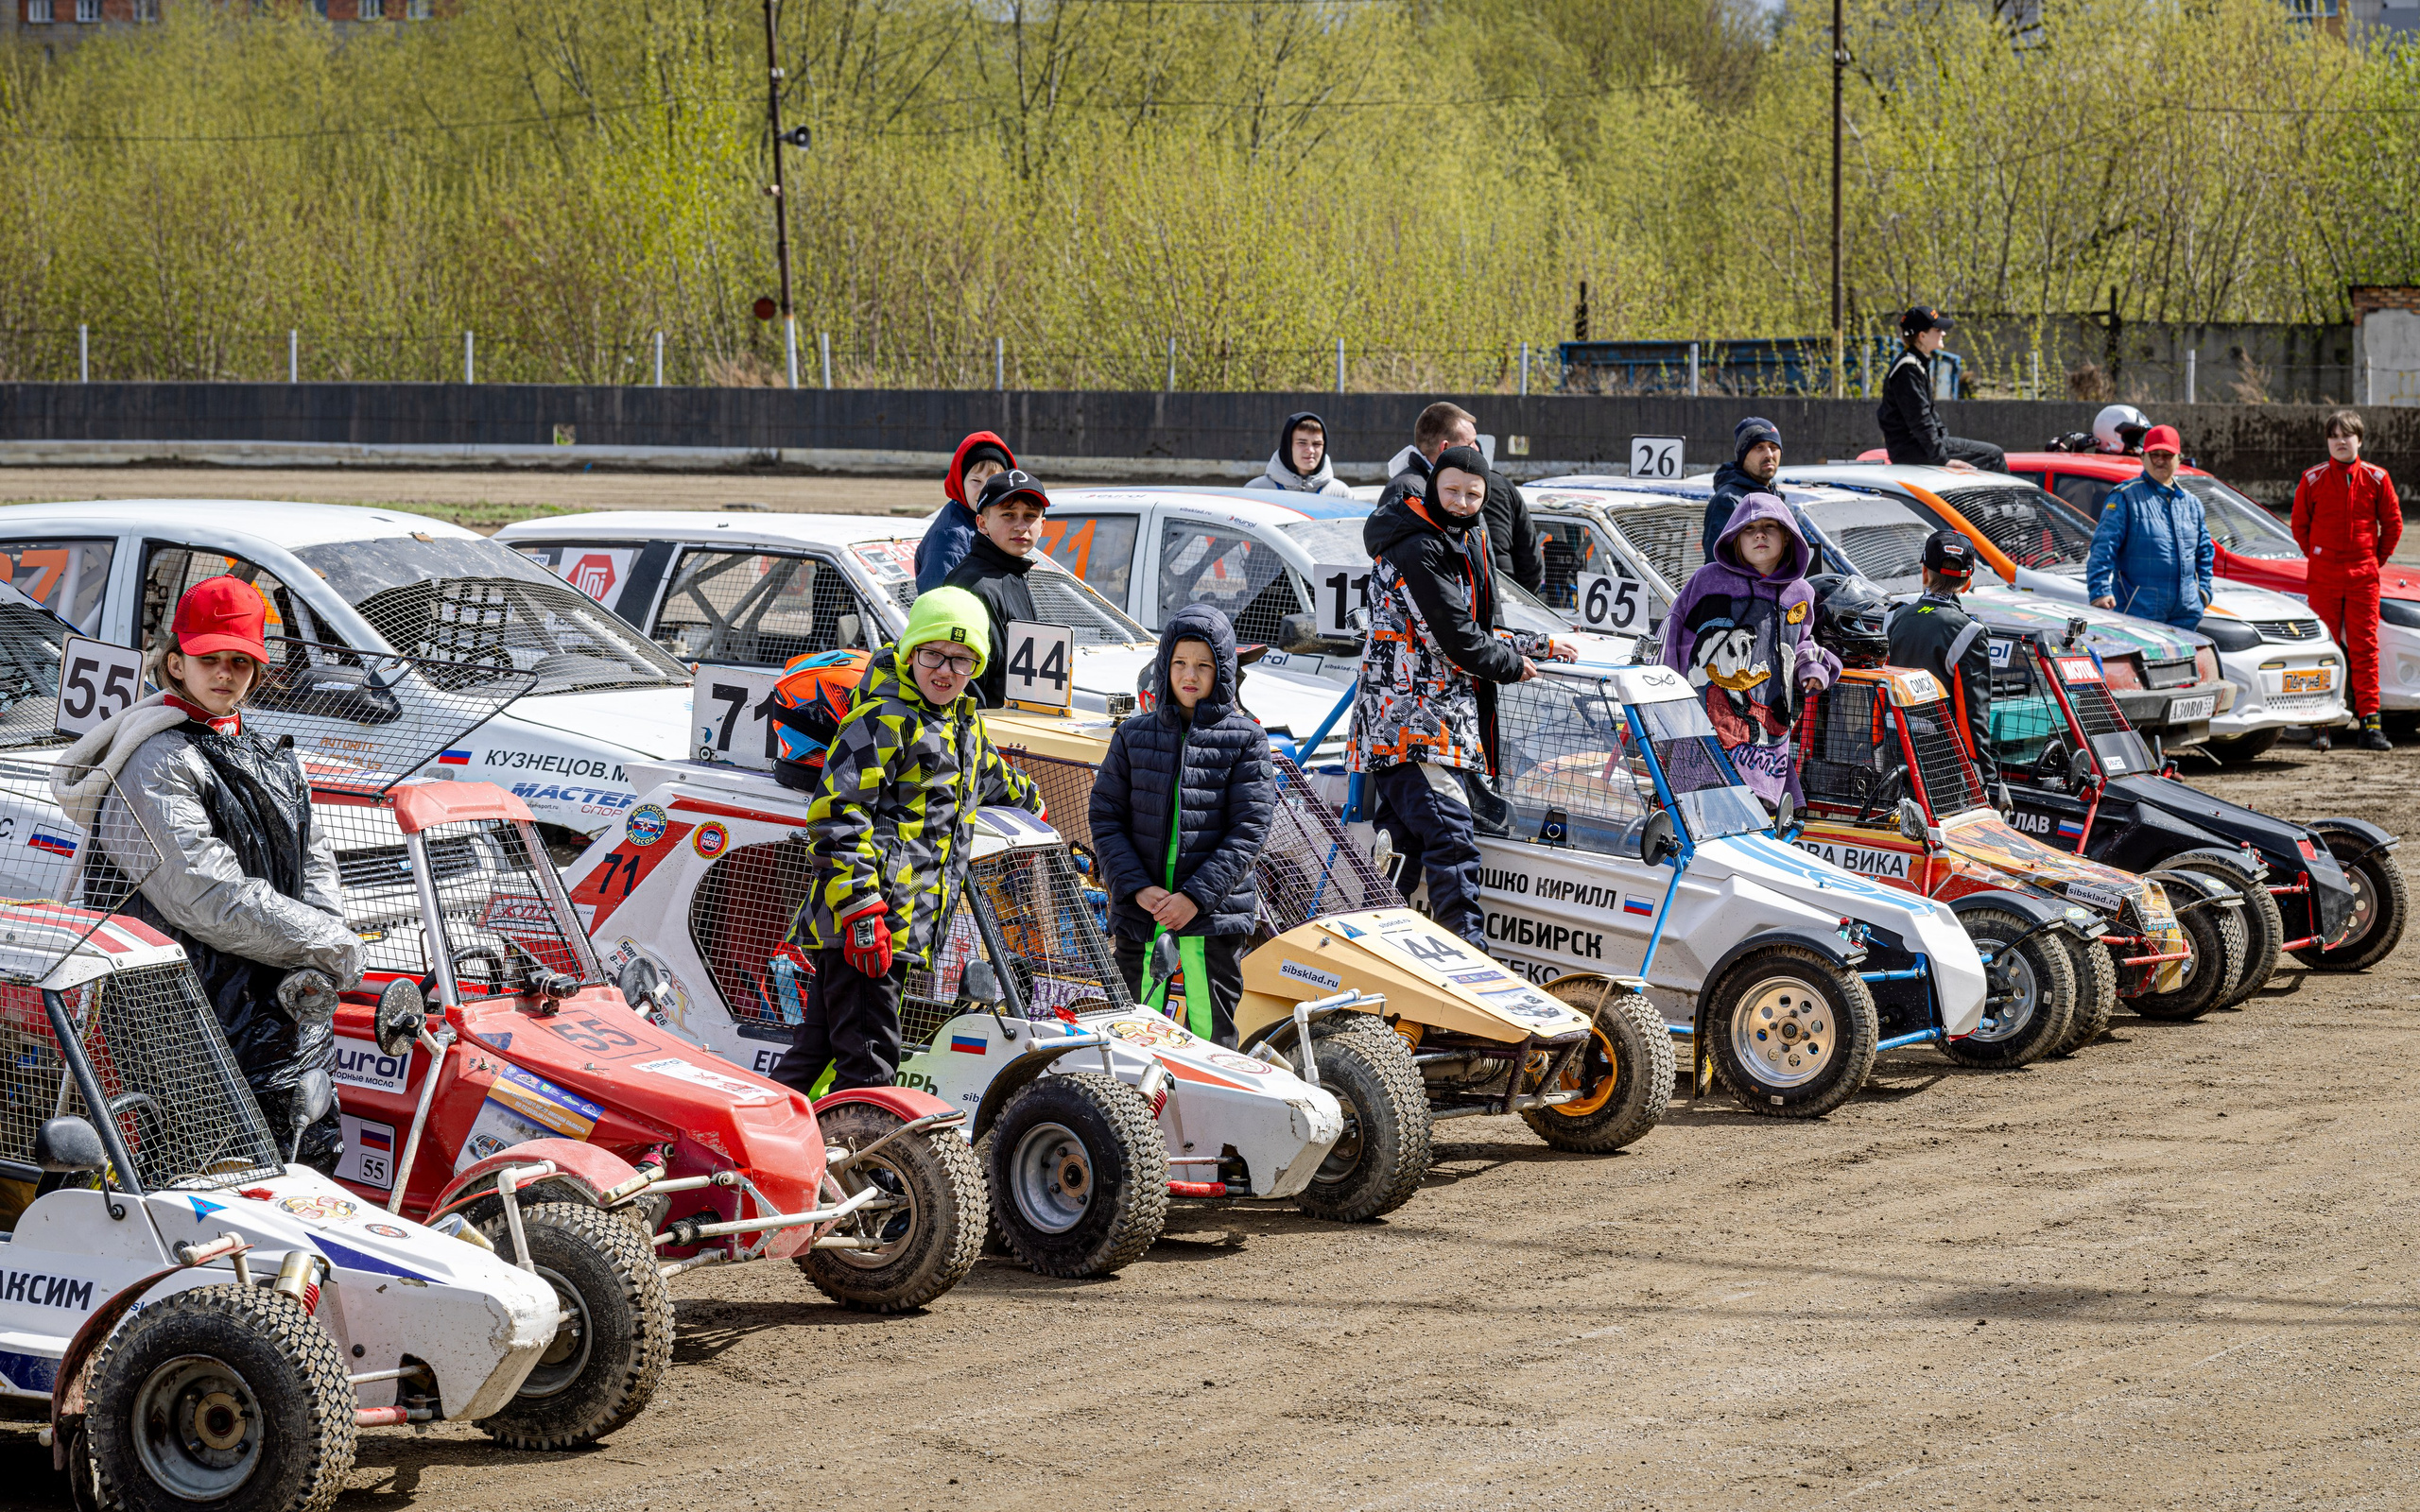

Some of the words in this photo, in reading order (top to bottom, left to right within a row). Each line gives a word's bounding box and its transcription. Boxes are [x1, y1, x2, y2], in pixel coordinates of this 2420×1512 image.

[1637, 444, 1677, 477] 26
[1179, 506, 1213, 516] sibsklad.ru
[1234, 516, 1258, 529] eurol
[529, 555, 548, 563] urol
[1039, 519, 1098, 582] 71
[1584, 577, 1640, 628] 65
[1008, 636, 1068, 691] 44
[1259, 653, 1290, 666] rol
[2060, 660, 2100, 680] MOTUL
[63, 656, 135, 722] 55
[1909, 675, 1936, 695] ОМСК
[2204, 697, 2213, 711] 55
[711, 682, 779, 759] 71
[484, 748, 630, 783] КУЗНЕЦОВ.М
[511, 782, 639, 809] МАСТЕР
[580, 803, 624, 817] СПОР
[631, 804, 647, 818] МЧС
[647, 804, 666, 827] РОССИИ
[700, 821, 721, 830] MADE
[626, 829, 658, 845] EMERCOM
[701, 838, 720, 849] MOLY
[702, 833, 720, 842] LIQUI
[694, 845, 723, 861] GERMANY
[1842, 848, 1905, 878] ВИКА
[597, 852, 641, 897] 71
[1535, 876, 1617, 910] КИРИЛЛ
[2067, 886, 2120, 908] sibsklad.ru
[1402, 935, 1469, 963] 44
[1281, 963, 1340, 988] sibsklad.ru
[548, 1019, 638, 1052] 55
[337, 1047, 408, 1080] urol
[334, 1071, 365, 1083] торные
[365, 1077, 394, 1089] масла
[363, 1158, 386, 1180] 55
